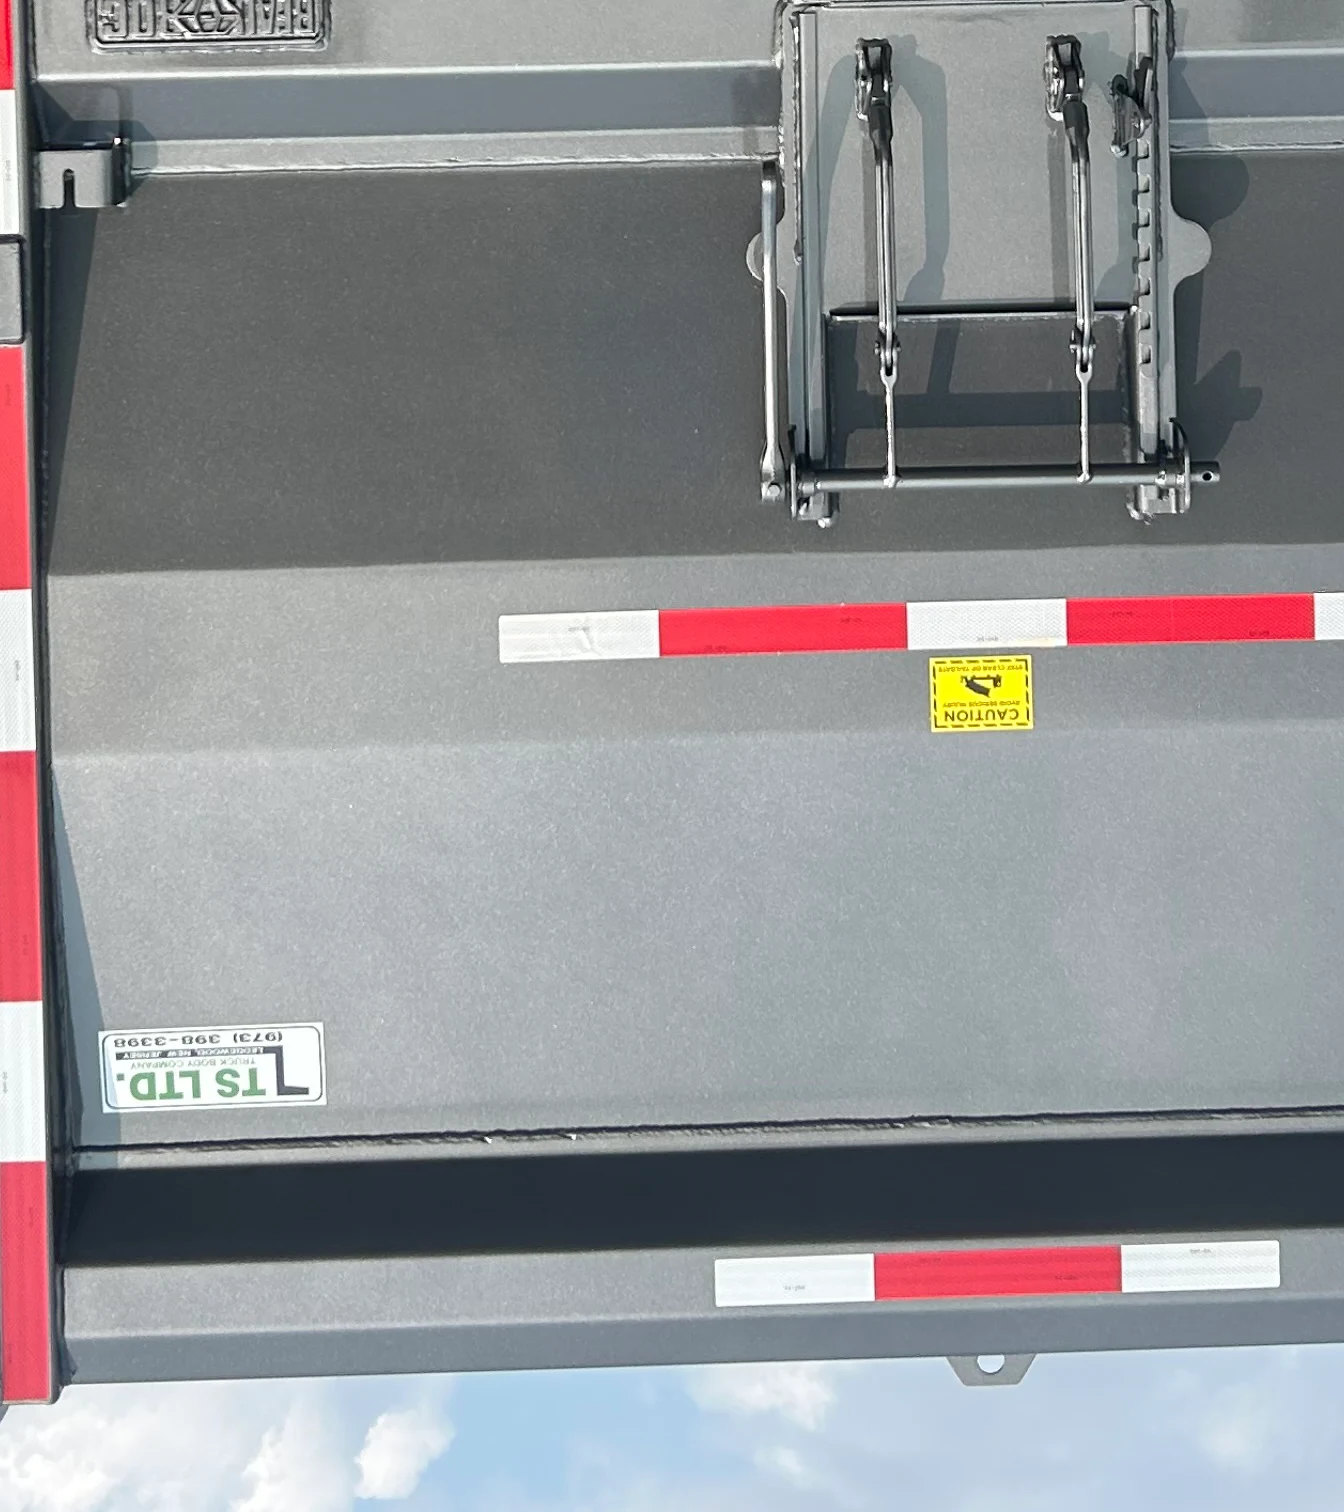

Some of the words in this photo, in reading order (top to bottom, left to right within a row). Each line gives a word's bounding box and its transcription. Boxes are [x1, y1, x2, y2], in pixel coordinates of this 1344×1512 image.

[943, 708, 1018, 721] CAUTION
[113, 1033, 219, 1046] 398-3398
[232, 1030, 282, 1042] (973)
[130, 1059, 183, 1068] COMPANY
[187, 1058, 215, 1066] BODY
[218, 1057, 255, 1065] TRUCK
[115, 1069, 199, 1100] LTD.
[214, 1067, 265, 1096] TS
